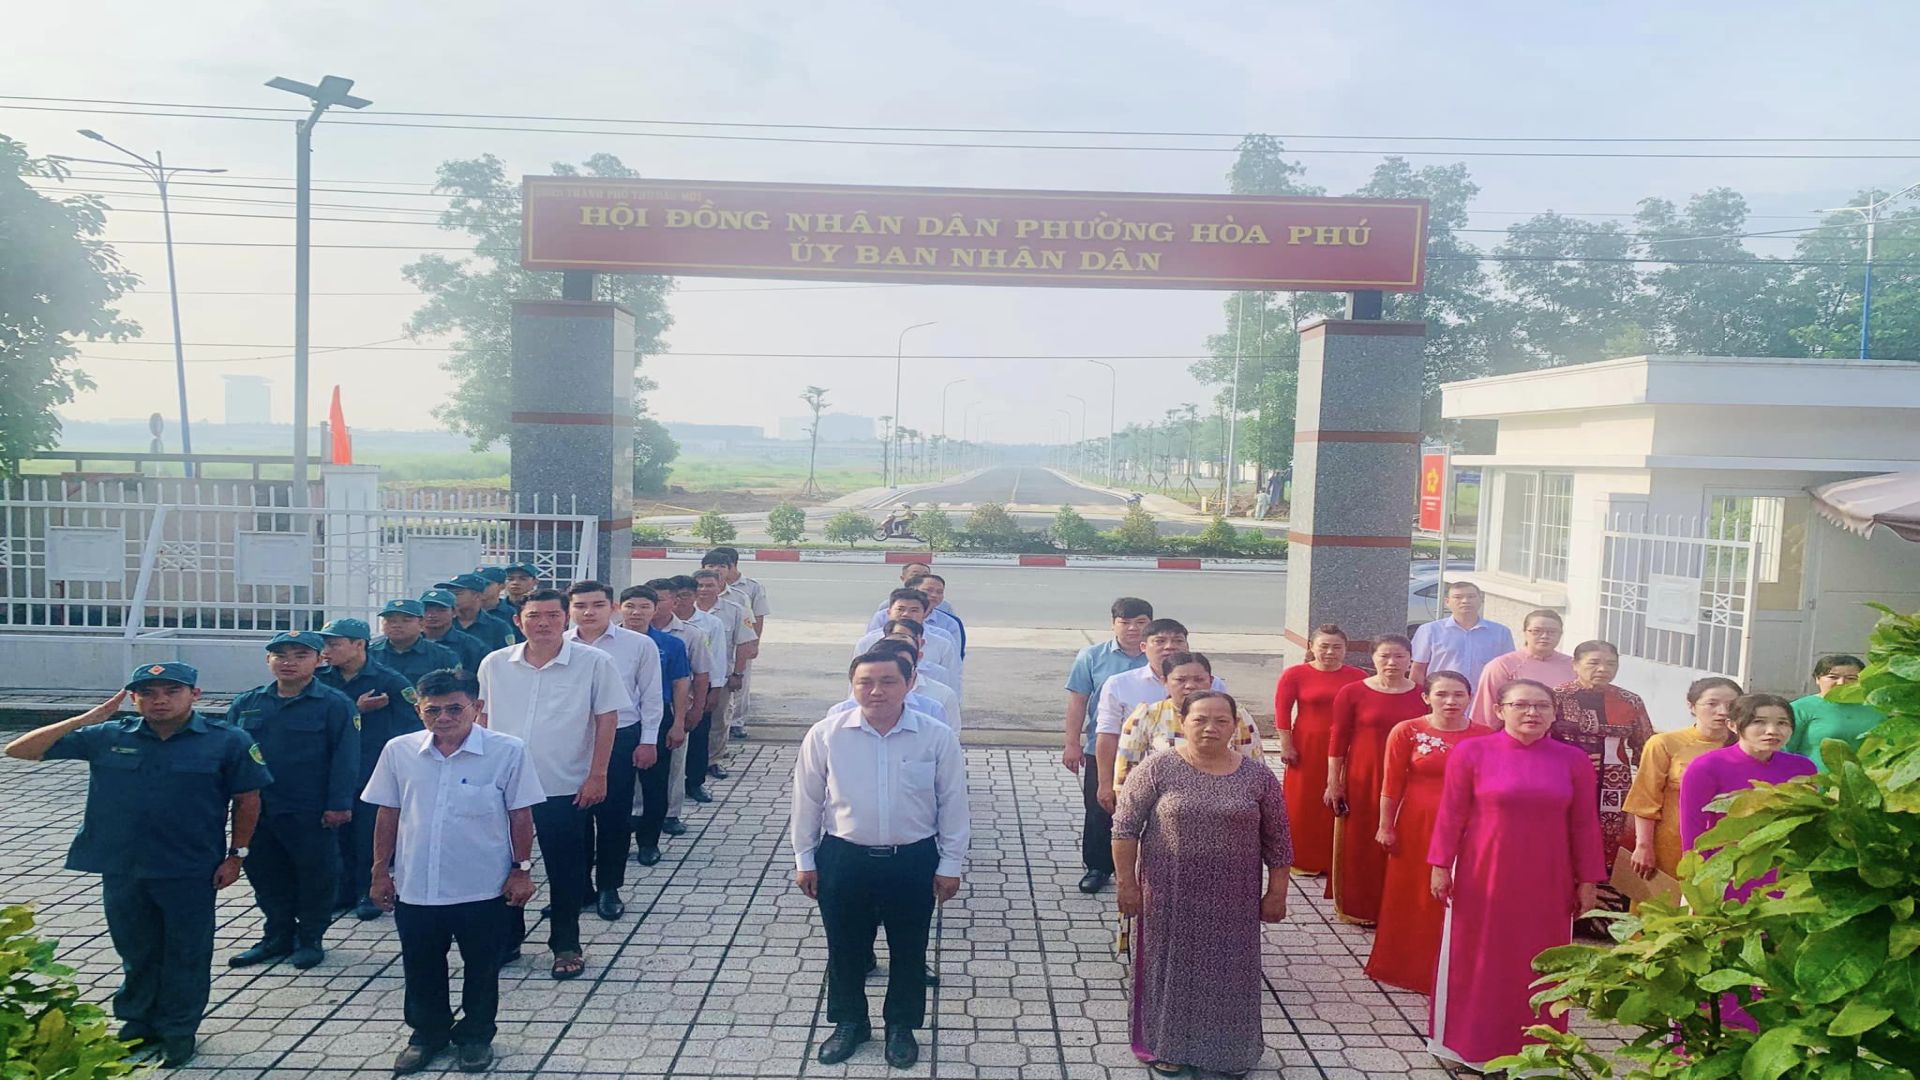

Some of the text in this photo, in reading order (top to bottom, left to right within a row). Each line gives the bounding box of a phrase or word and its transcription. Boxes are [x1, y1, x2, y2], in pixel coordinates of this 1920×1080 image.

[579, 199, 1372, 246] HỘI ĐỒNG NHÂN DÂN PHƯỜNG HÒA PHÚ
[789, 236, 1163, 271] ỦY BAN NHÂN DÂN
